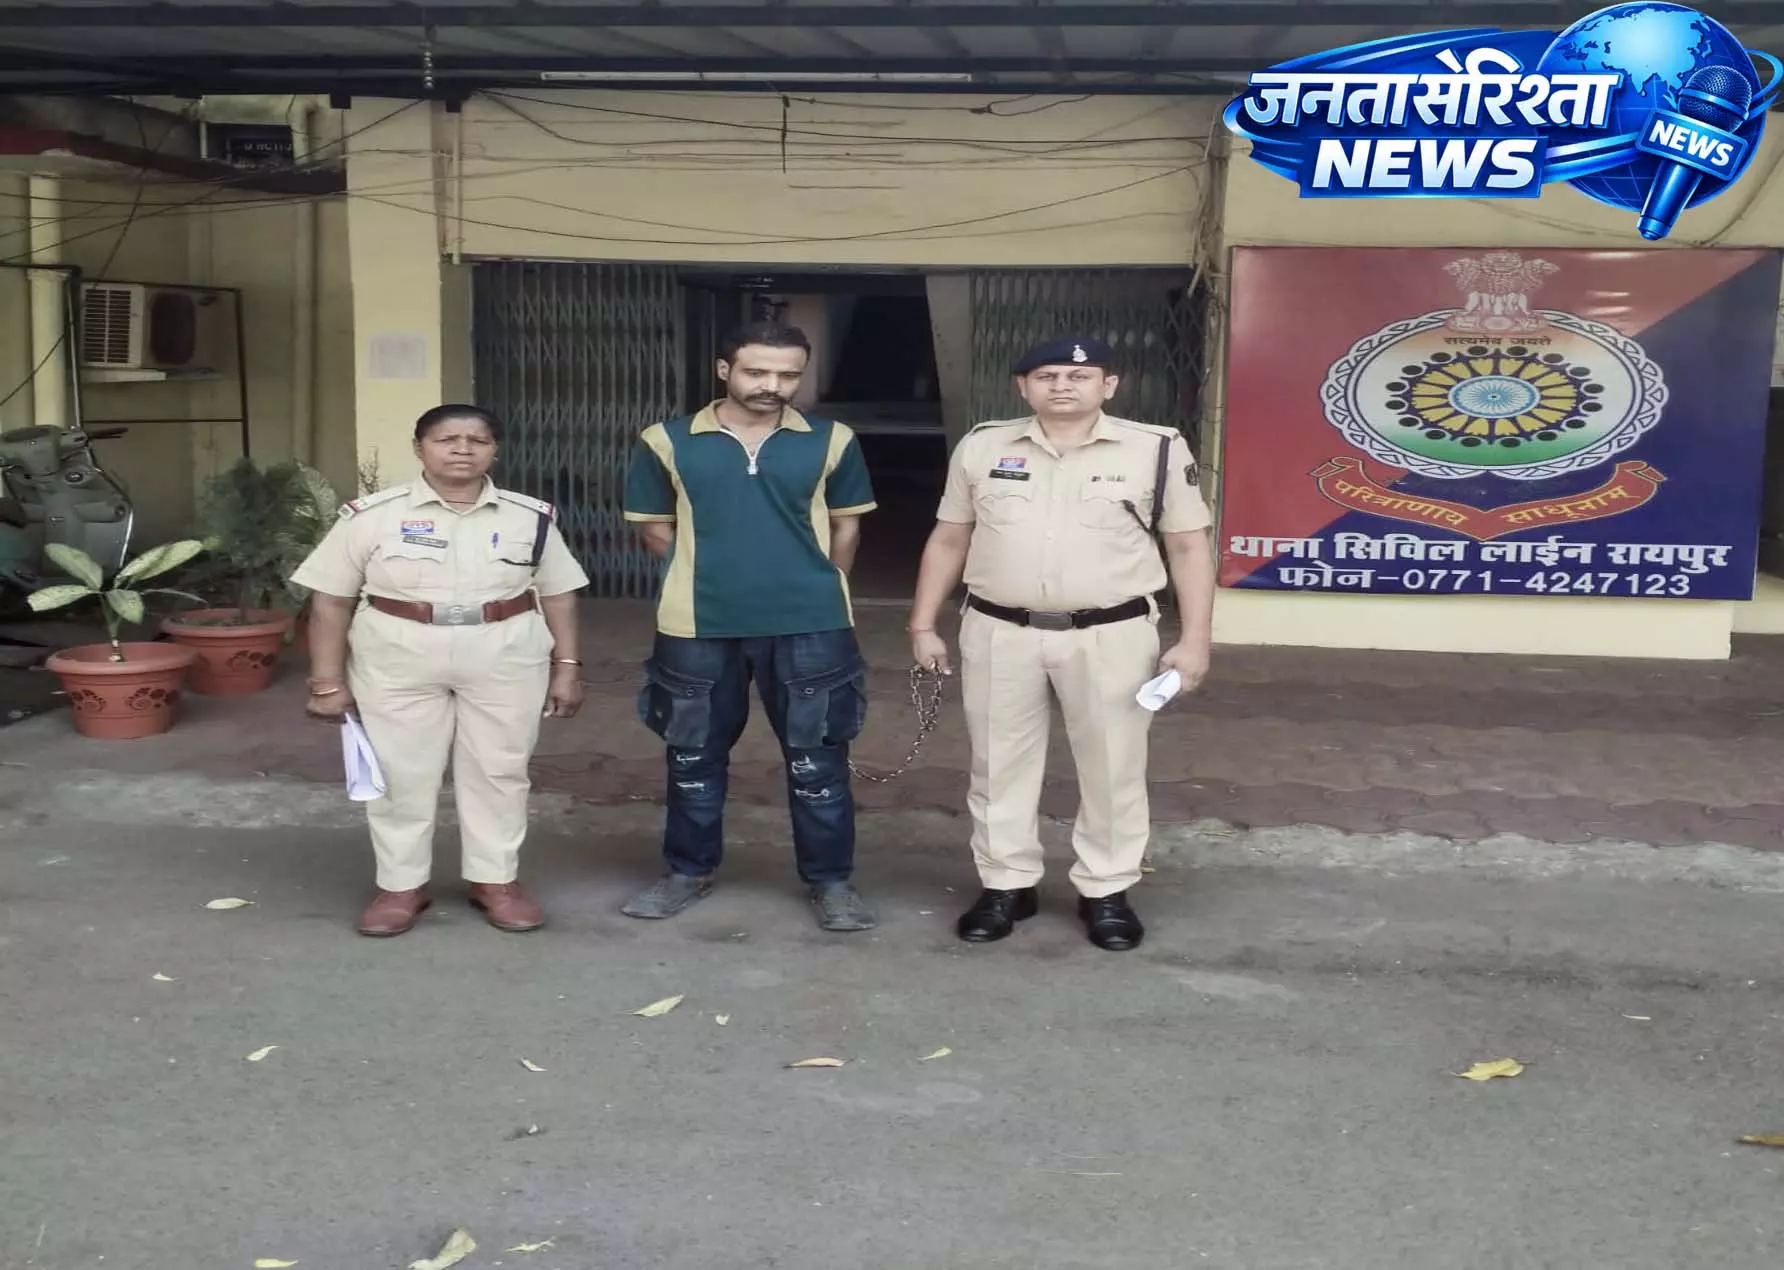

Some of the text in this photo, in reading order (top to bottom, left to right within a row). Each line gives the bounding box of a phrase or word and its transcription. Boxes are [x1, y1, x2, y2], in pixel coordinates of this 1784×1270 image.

[1230, 532, 1733, 574] थाना सिविल लाईन रायपुर
